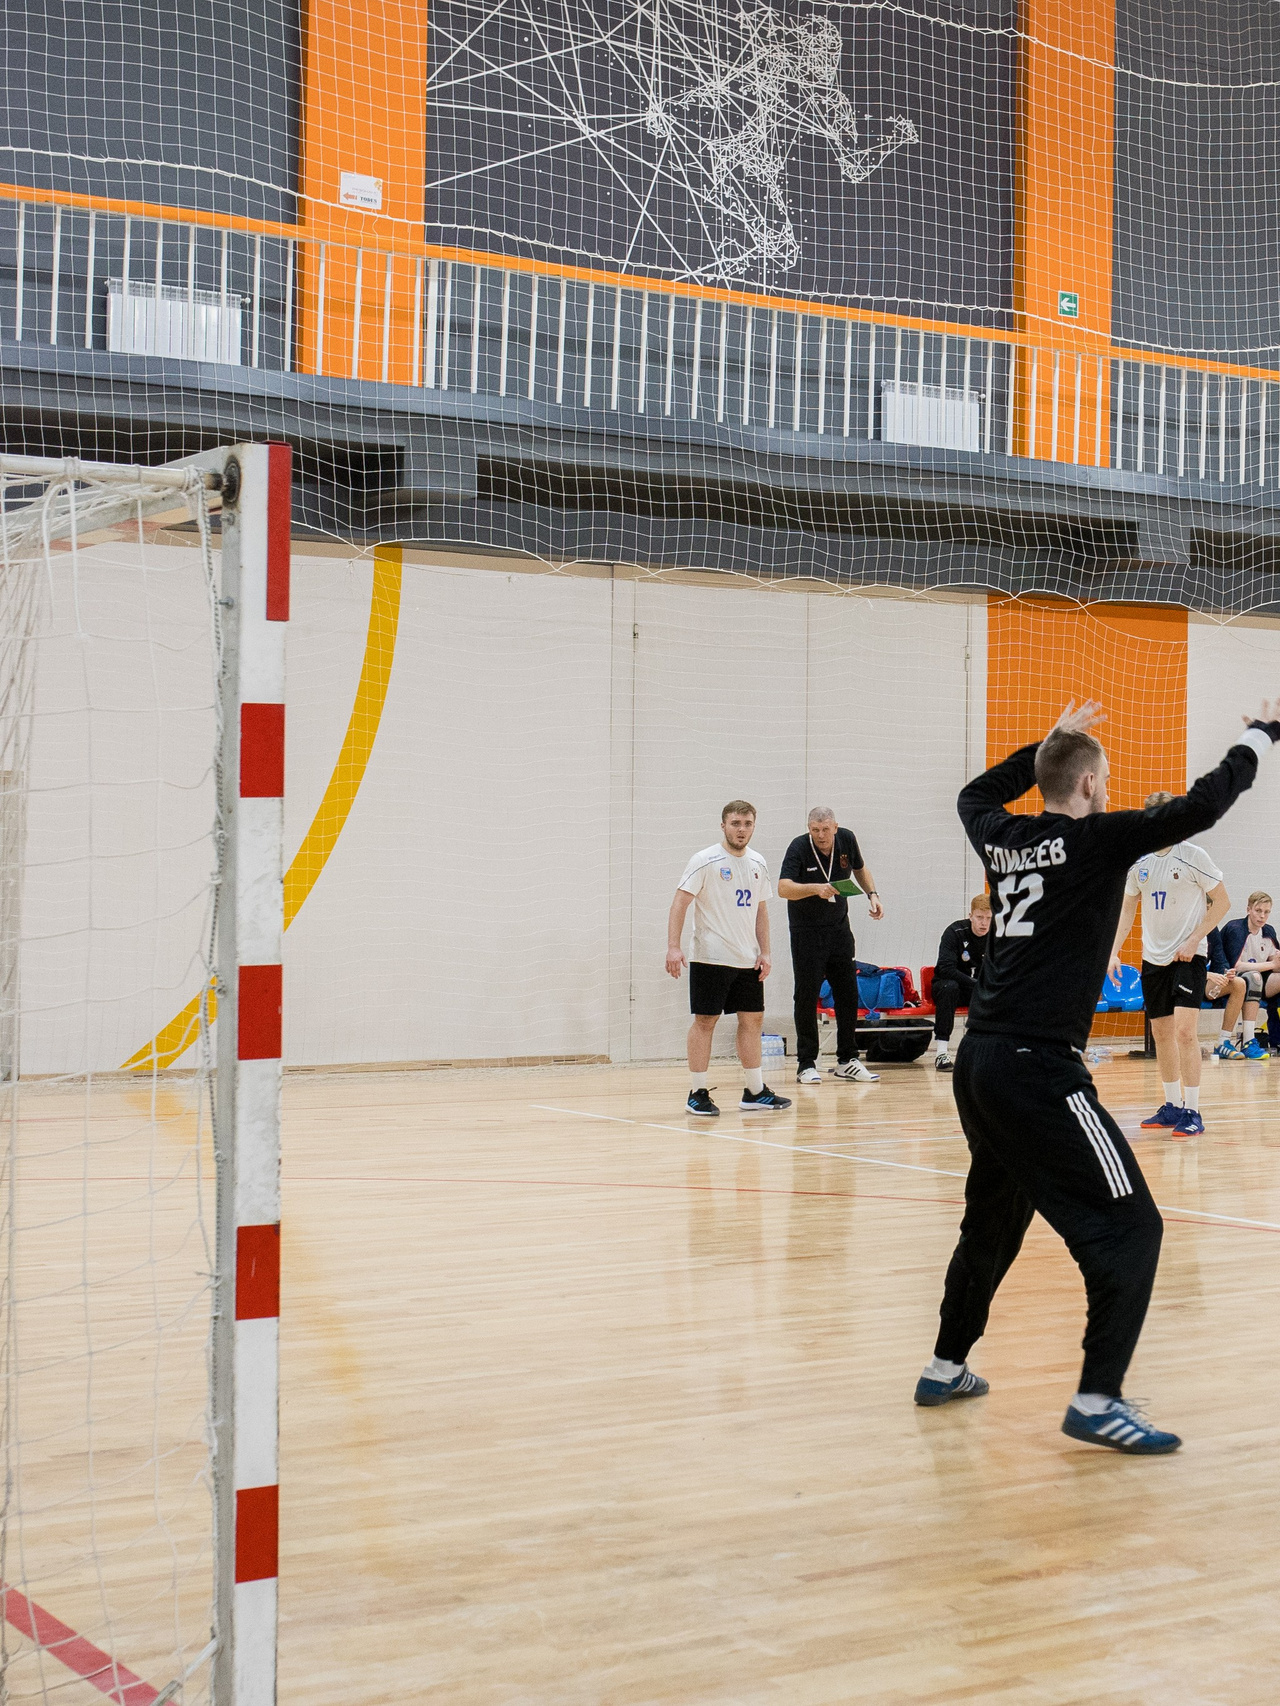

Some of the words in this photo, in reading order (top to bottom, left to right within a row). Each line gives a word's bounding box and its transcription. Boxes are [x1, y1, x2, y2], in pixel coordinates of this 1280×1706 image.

[735, 889, 752, 907] 22
[995, 872, 1044, 937] 12
[1151, 891, 1167, 910] 17
